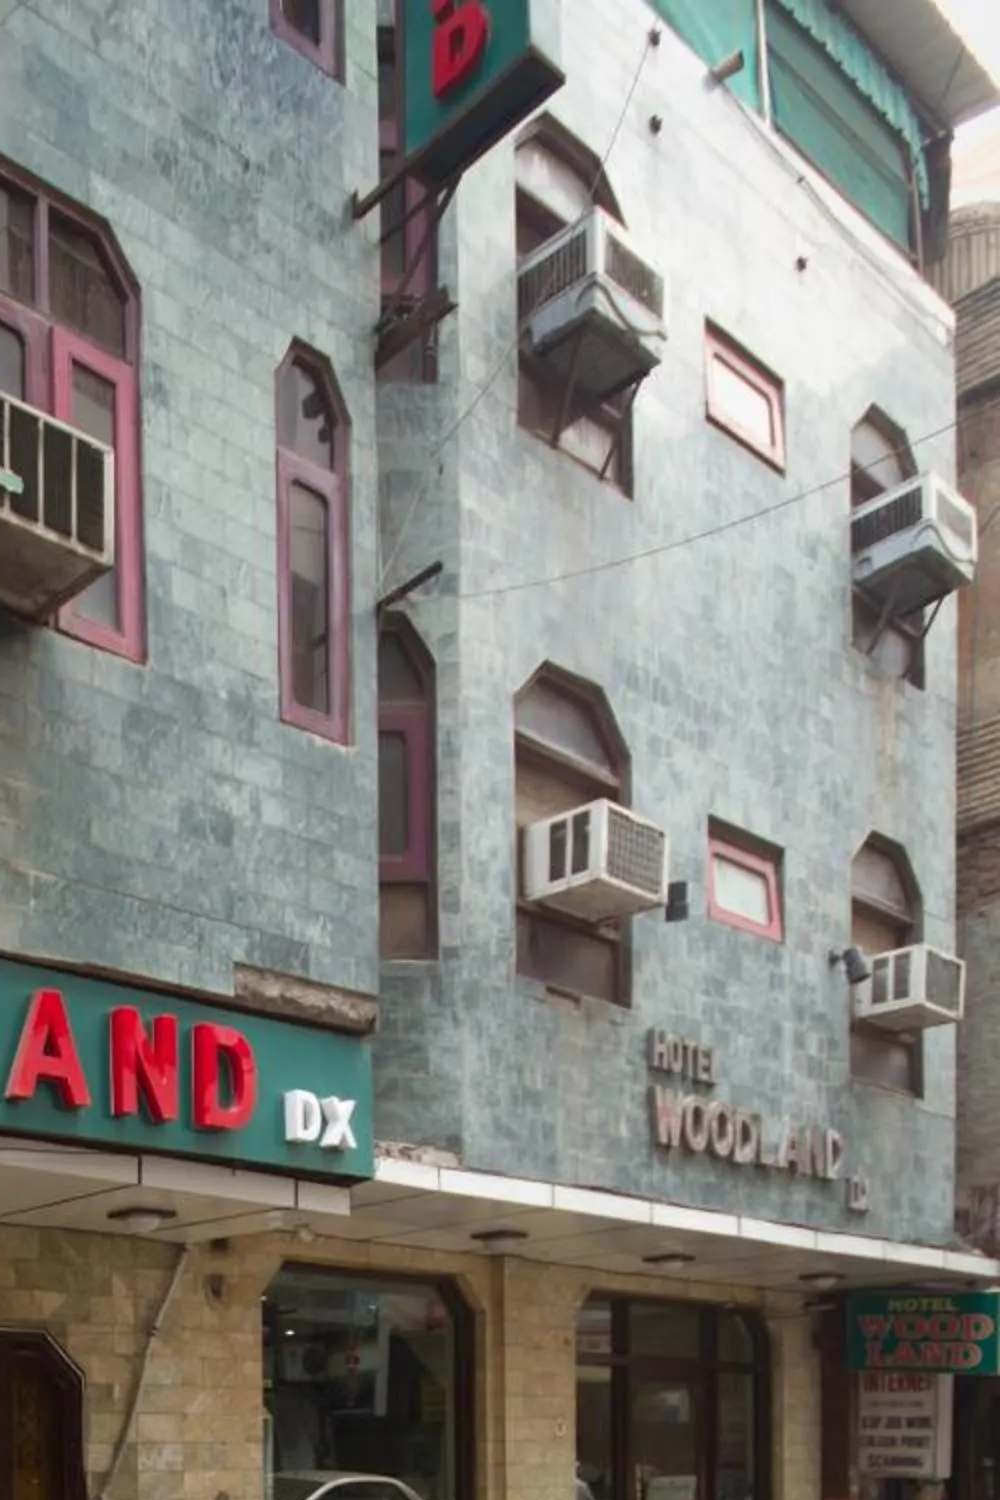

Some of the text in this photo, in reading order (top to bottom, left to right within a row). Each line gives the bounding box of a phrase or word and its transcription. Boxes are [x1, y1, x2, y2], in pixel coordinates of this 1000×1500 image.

[284, 1088, 357, 1152] DX
[650, 1084, 845, 1181] WOODLAND
[887, 1297, 958, 1312] HOTEL
[857, 1313, 995, 1341] WOOD
[865, 1341, 982, 1369] LAND
